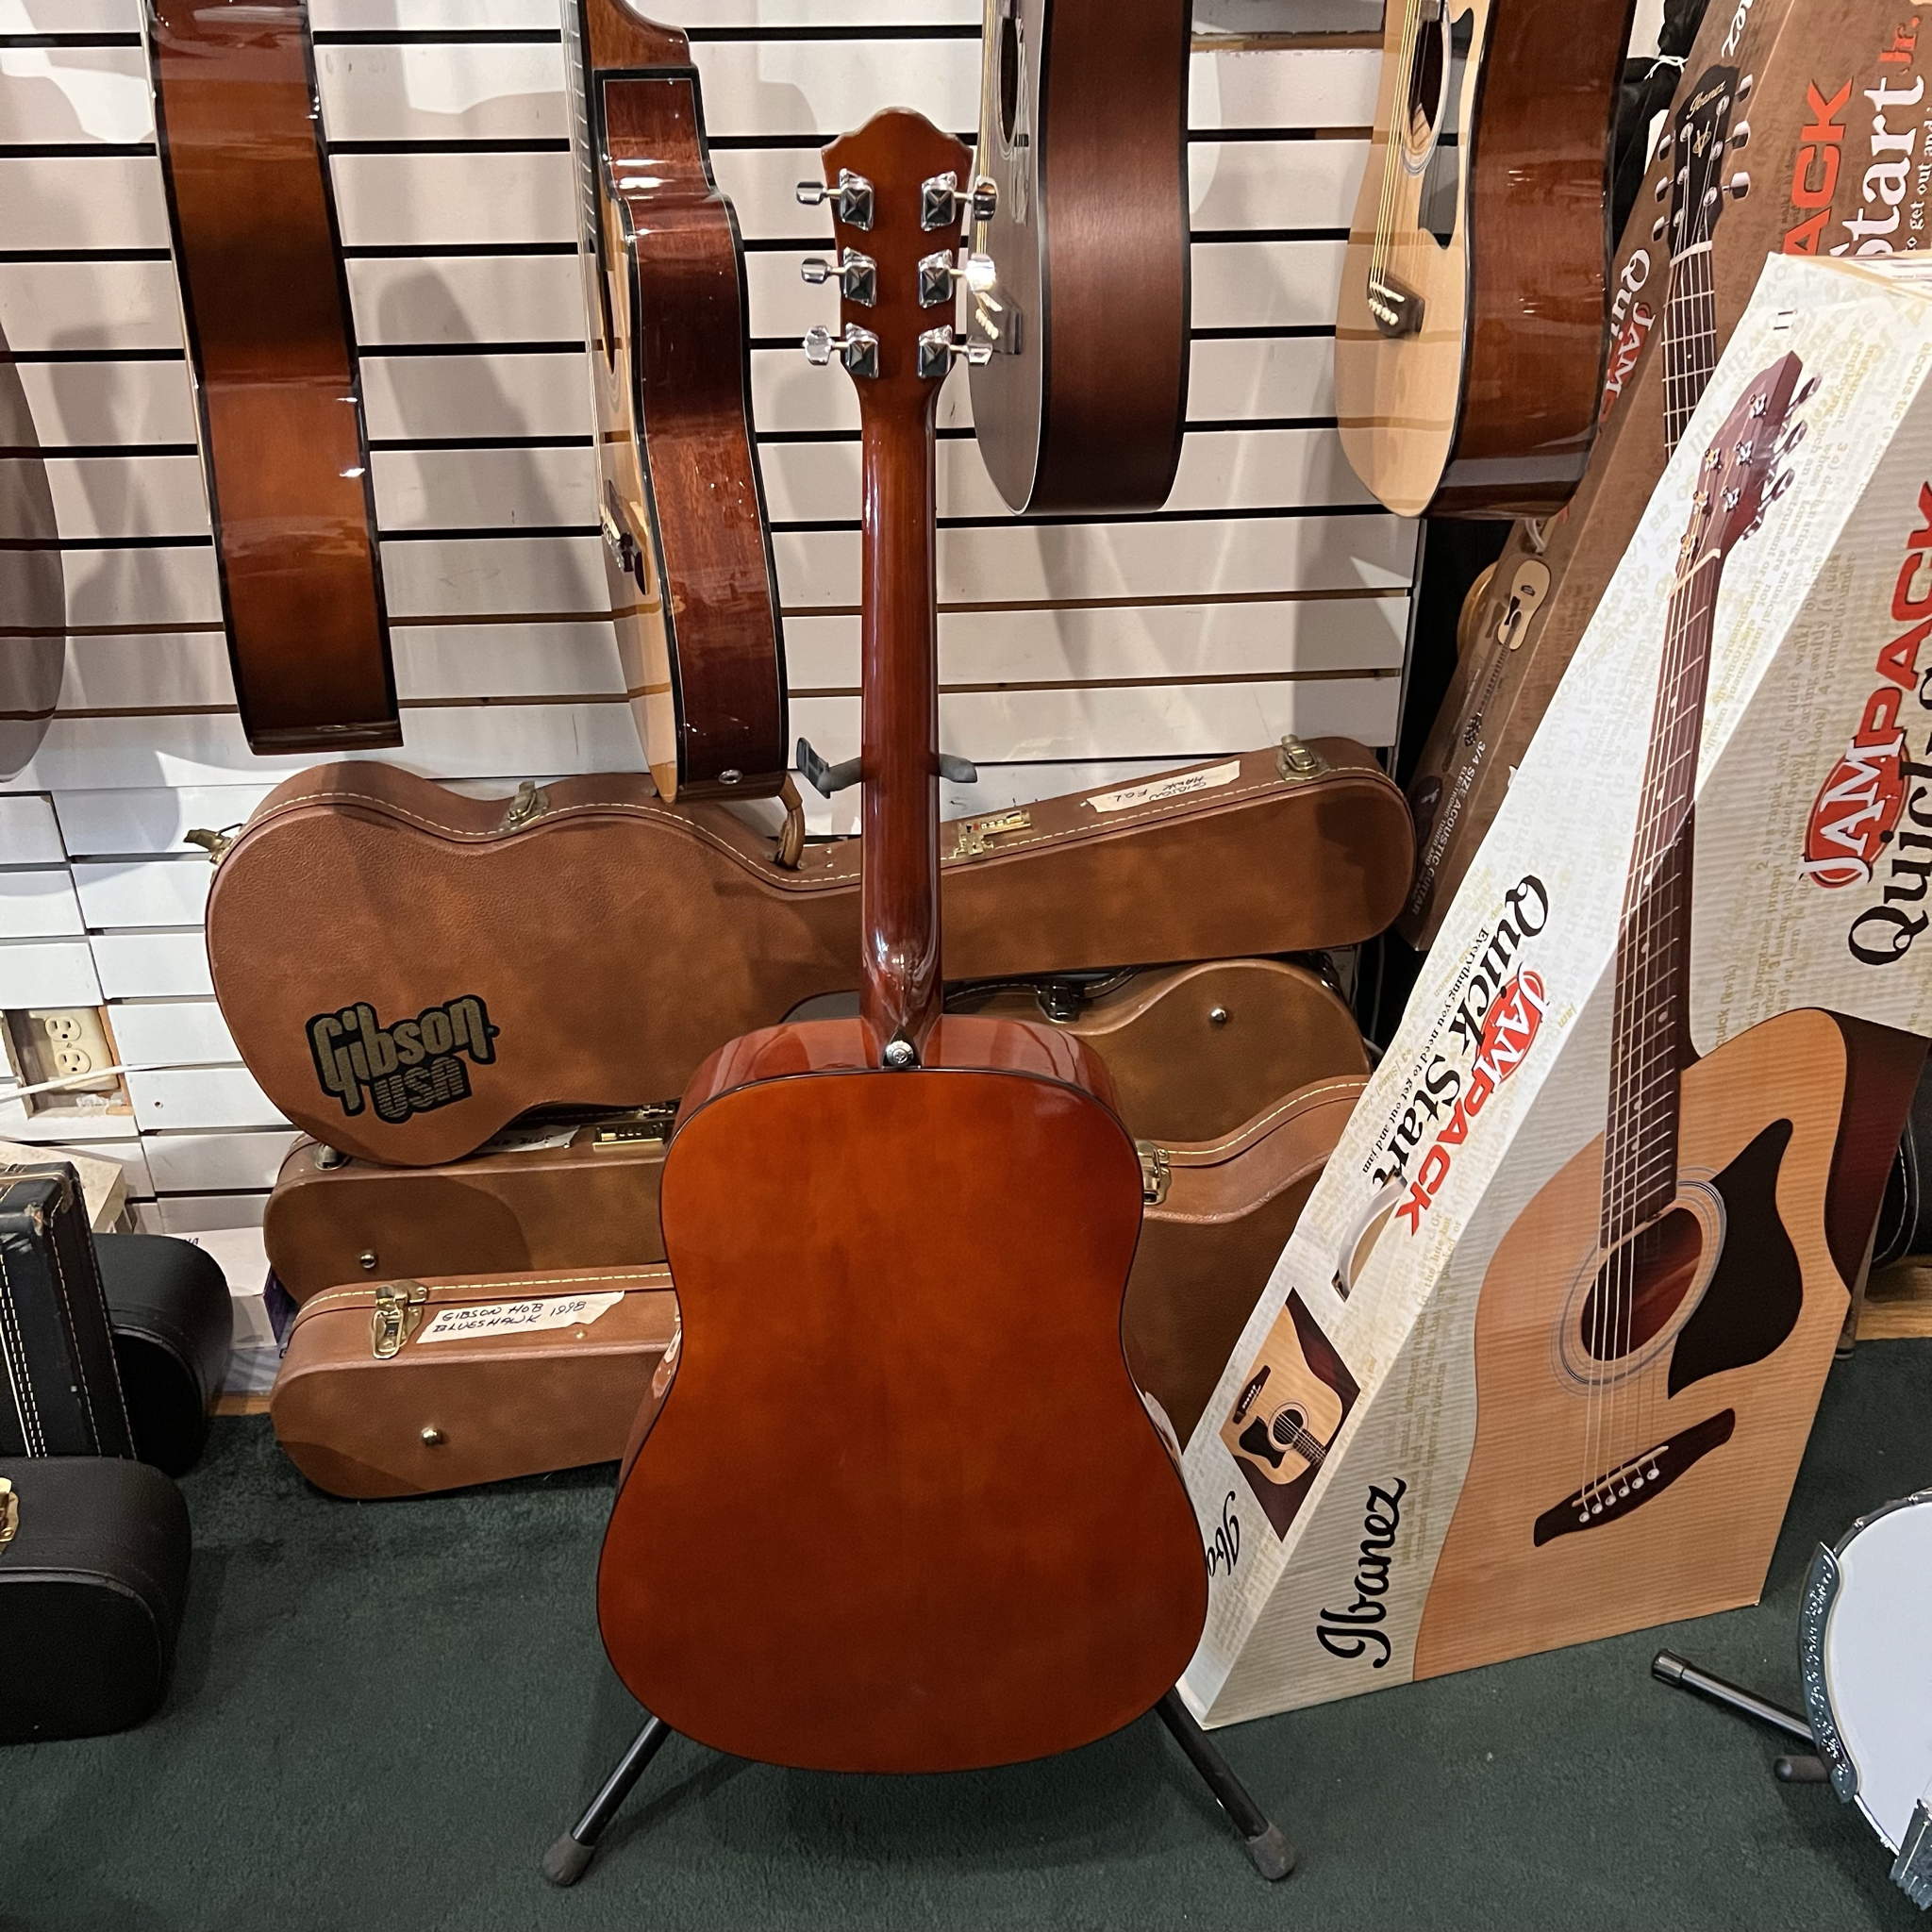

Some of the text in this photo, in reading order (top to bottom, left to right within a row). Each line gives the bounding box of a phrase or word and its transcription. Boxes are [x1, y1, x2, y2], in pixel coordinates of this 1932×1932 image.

[1782, 75, 1854, 256] ACK
[1909, 200, 1925, 230] get
[1917, 162, 1932, 195] out
[1610, 249, 1650, 340] Qui
[1602, 302, 1656, 411] JAM
[1457, 766, 1476, 798] SIZE
[1471, 740, 1487, 764] 3/4
[1441, 765, 1469, 819] ELECTRONIC
[1429, 799, 1463, 865] ACOUSTIC
[1409, 866, 1436, 915] GUITAR
[313, 998, 489, 1110] Gibson
[1360, 927, 1489, 1175] Everything you need to get out and jam
[1372, 874, 1549, 1189] Quick Start
[375, 1057, 464, 1118] USA
[432, 1314, 542, 1333] BLUESHAWK
[442, 1306, 502, 1322] GIBSON
[550, 1301, 587, 1317] 1998
[1208, 1491, 1241, 1577] Iba
[1316, 1477, 1407, 1668] Ibanez
